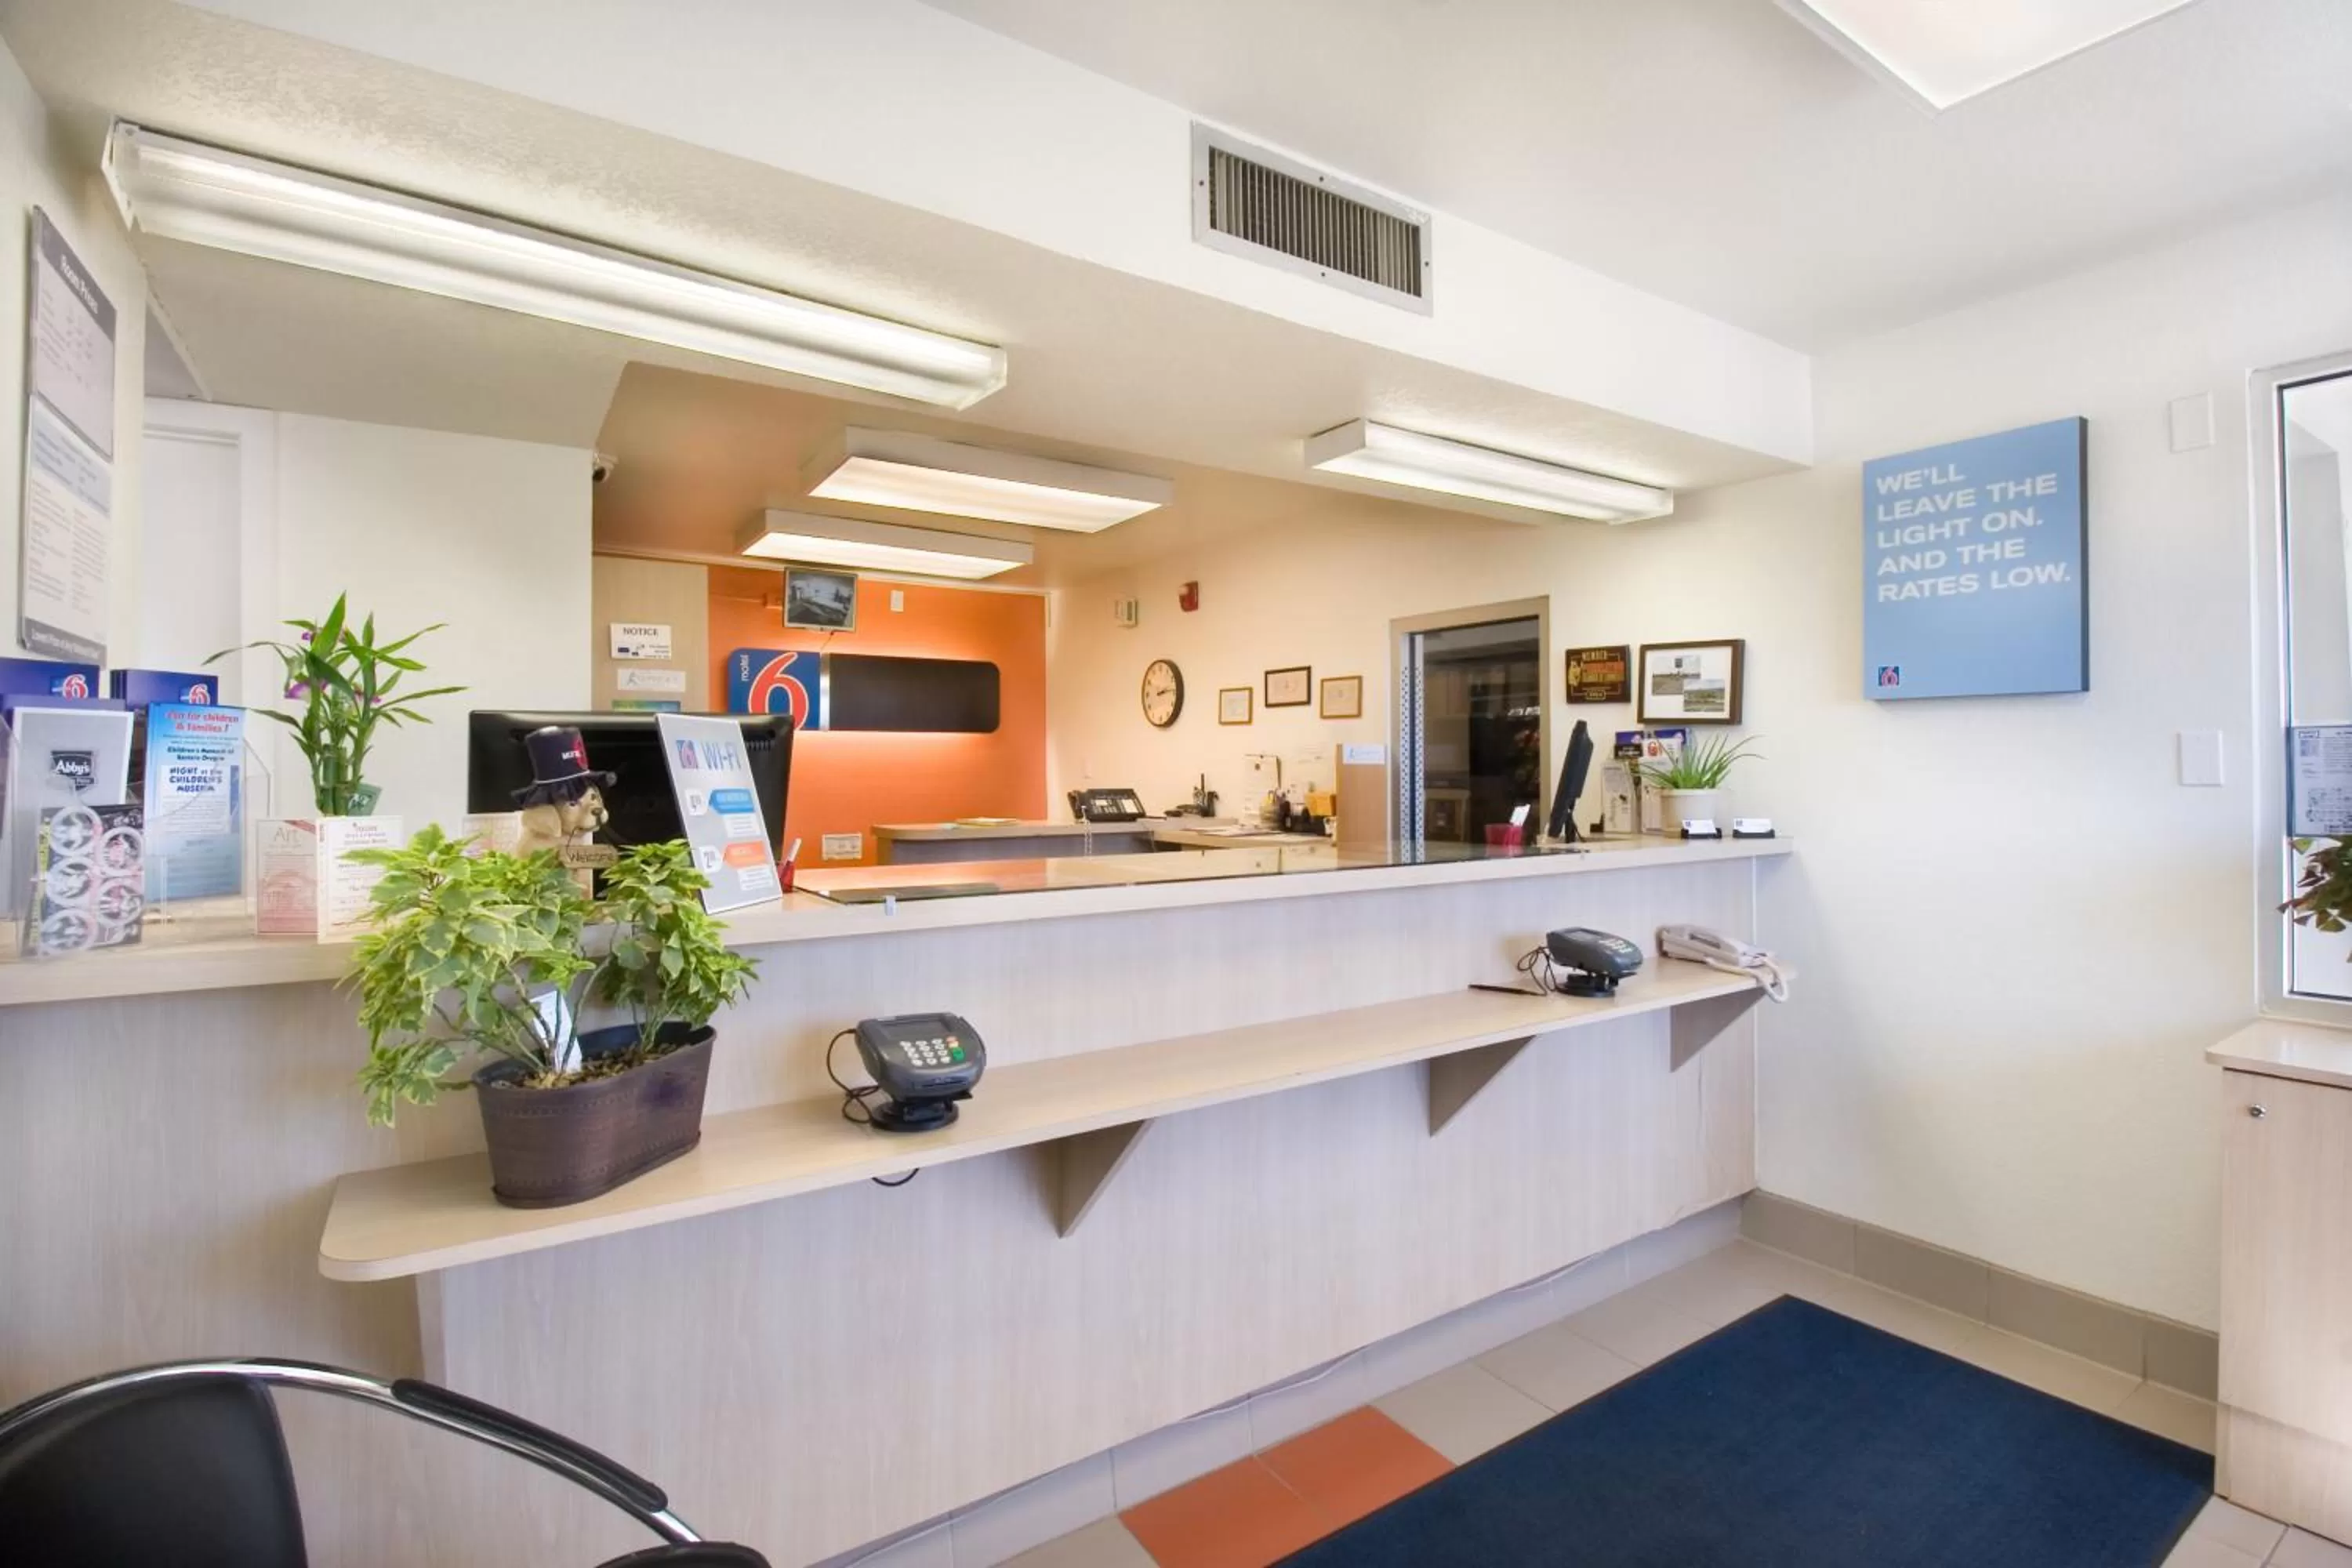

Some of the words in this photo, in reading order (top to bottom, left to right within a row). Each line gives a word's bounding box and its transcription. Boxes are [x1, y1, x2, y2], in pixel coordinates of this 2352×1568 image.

[1876, 463, 1965, 495] WE'LL
[1878, 488, 1977, 522] LEAVE
[1986, 473, 2057, 503] THE
[1878, 517, 1973, 550] LIGHT
[1982, 506, 2044, 533] ON.
[1877, 550, 1947, 576] AND
[1957, 538, 2026, 565] THE
[1878, 573, 1980, 603] RATES
[1991, 561, 2071, 590] LOW.
[622, 626, 658, 637] NOTICE
[739, 654, 750, 681] motel
[62, 673, 89, 700] 6
[748, 652, 809, 730] 6
[187, 723, 223, 733] families
[202, 713, 239, 724] children
[56, 759, 90, 776] Abby's
[702, 742, 742, 771] WI-FI
